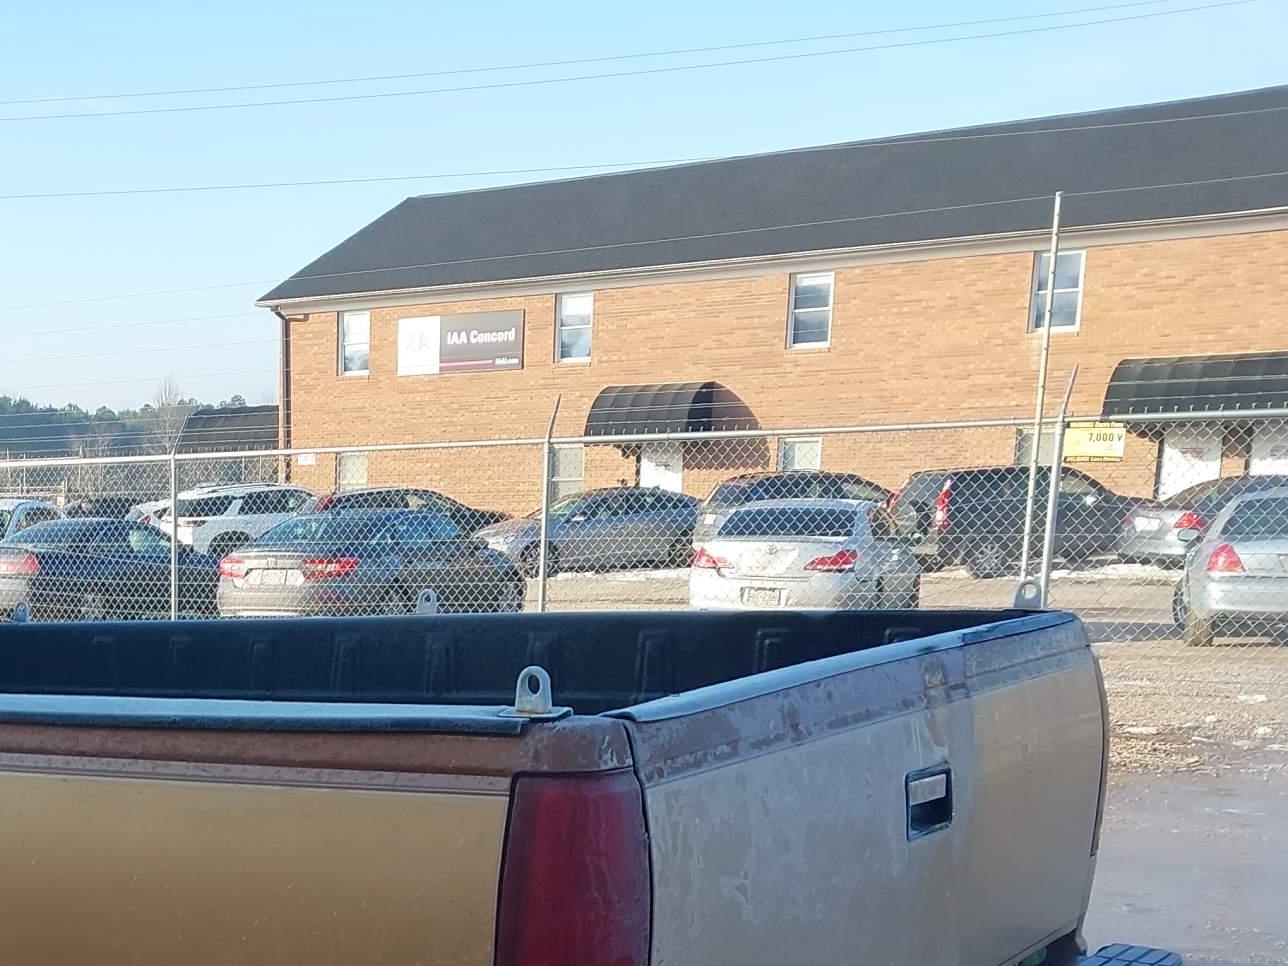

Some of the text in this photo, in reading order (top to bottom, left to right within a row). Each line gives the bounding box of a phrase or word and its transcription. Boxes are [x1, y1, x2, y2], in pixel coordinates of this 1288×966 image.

[447, 331, 467, 345] IAA
[470, 328, 516, 344] Concord
[1117, 433, 1123, 442] V
